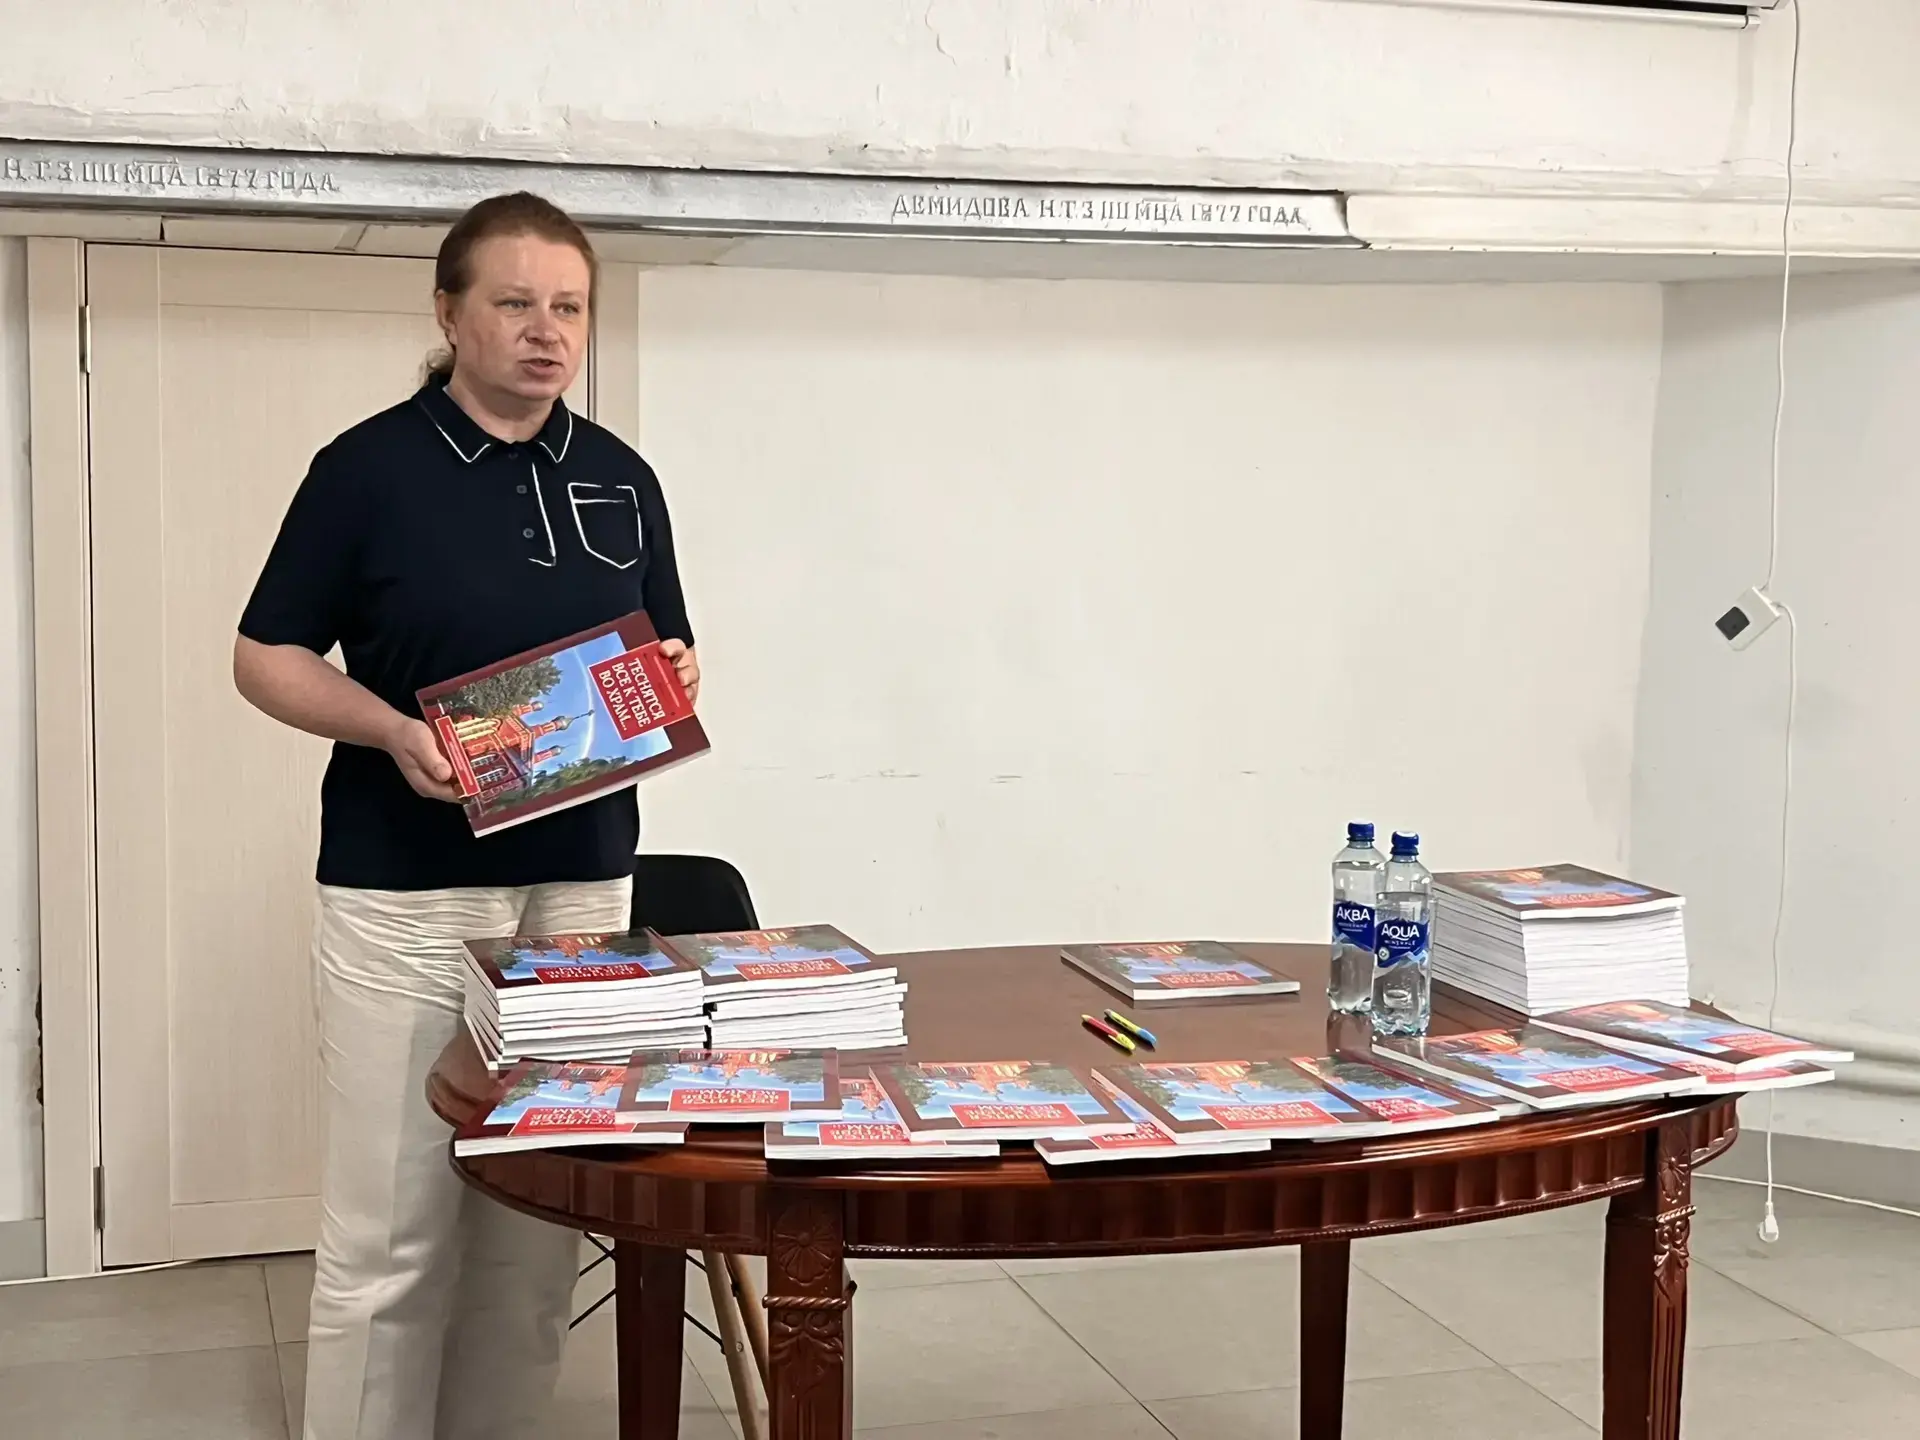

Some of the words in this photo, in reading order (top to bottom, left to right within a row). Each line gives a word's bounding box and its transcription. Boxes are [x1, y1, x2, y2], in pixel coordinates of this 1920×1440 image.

[598, 670, 615, 688] ВО
[611, 662, 632, 687] ВСЕ
[623, 686, 637, 697] К
[627, 657, 666, 720] ТЕСНЯТСЯ
[606, 688, 632, 731] ХРАМ...
[629, 696, 651, 728] ТЕБЕ
[1336, 906, 1371, 923] АКВА
[1381, 923, 1420, 941] AQUA
